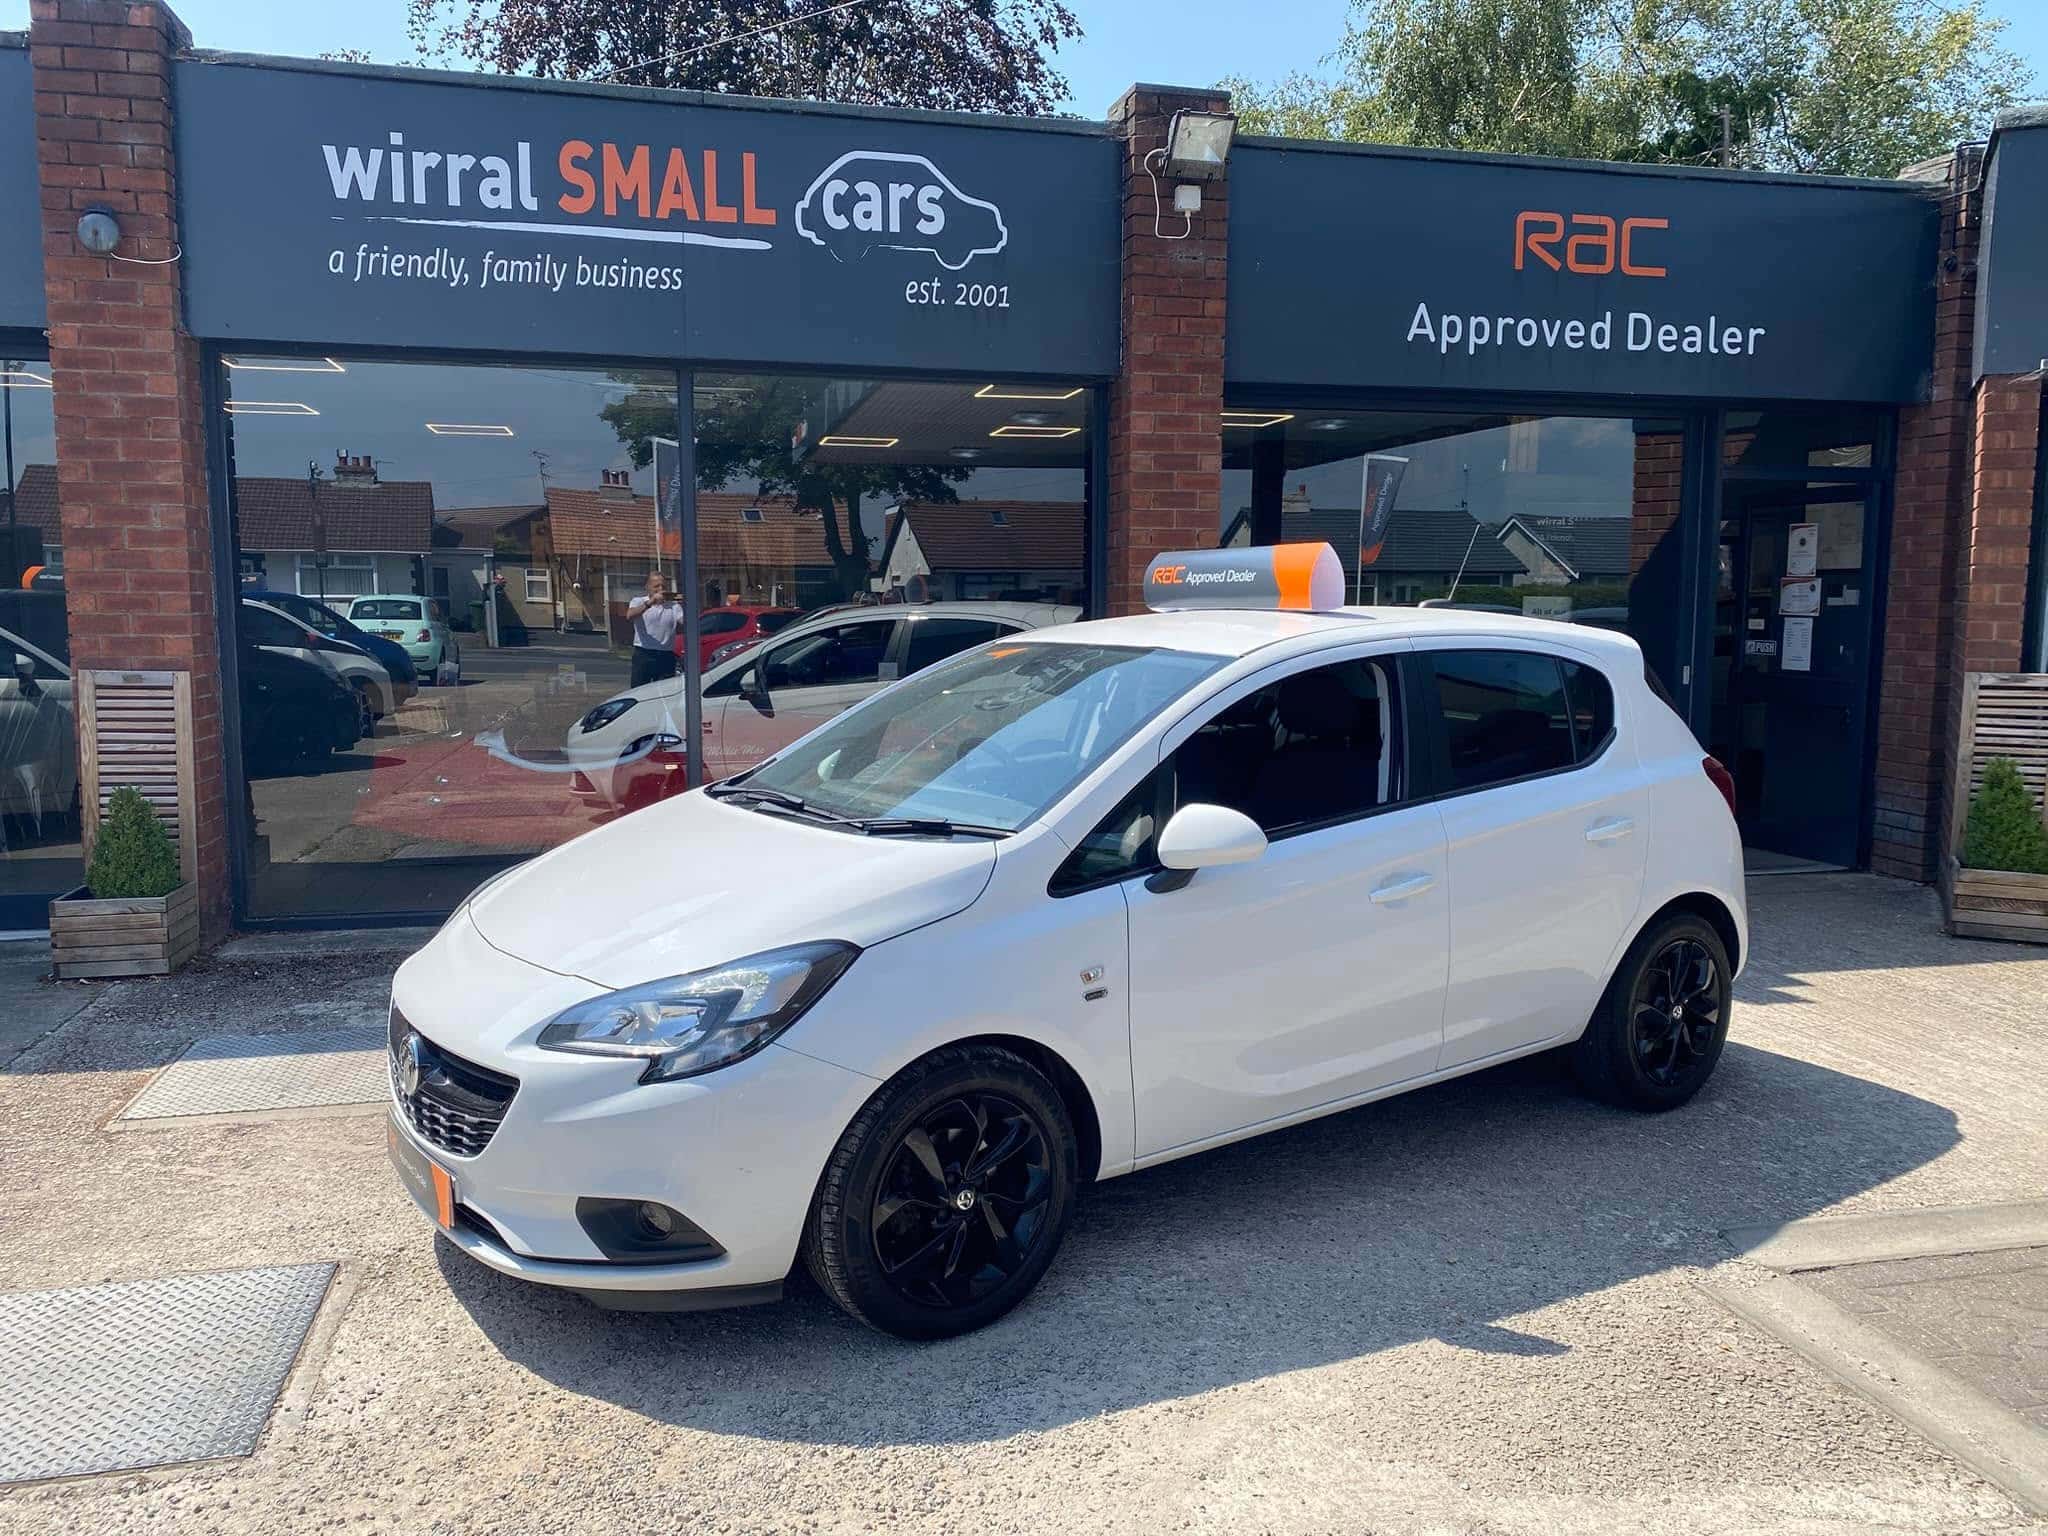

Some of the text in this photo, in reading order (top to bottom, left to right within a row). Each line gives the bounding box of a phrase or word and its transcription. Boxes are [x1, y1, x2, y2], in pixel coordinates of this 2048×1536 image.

[321, 131, 947, 235] wirral SMALL cars
[328, 243, 683, 292] a friendly, family business
[904, 277, 1011, 308] est. 2001
[1406, 302, 1766, 356] Approved Dealer
[1186, 569, 1257, 586] Approved Dealer
[1756, 642, 1775, 654] PUSH
